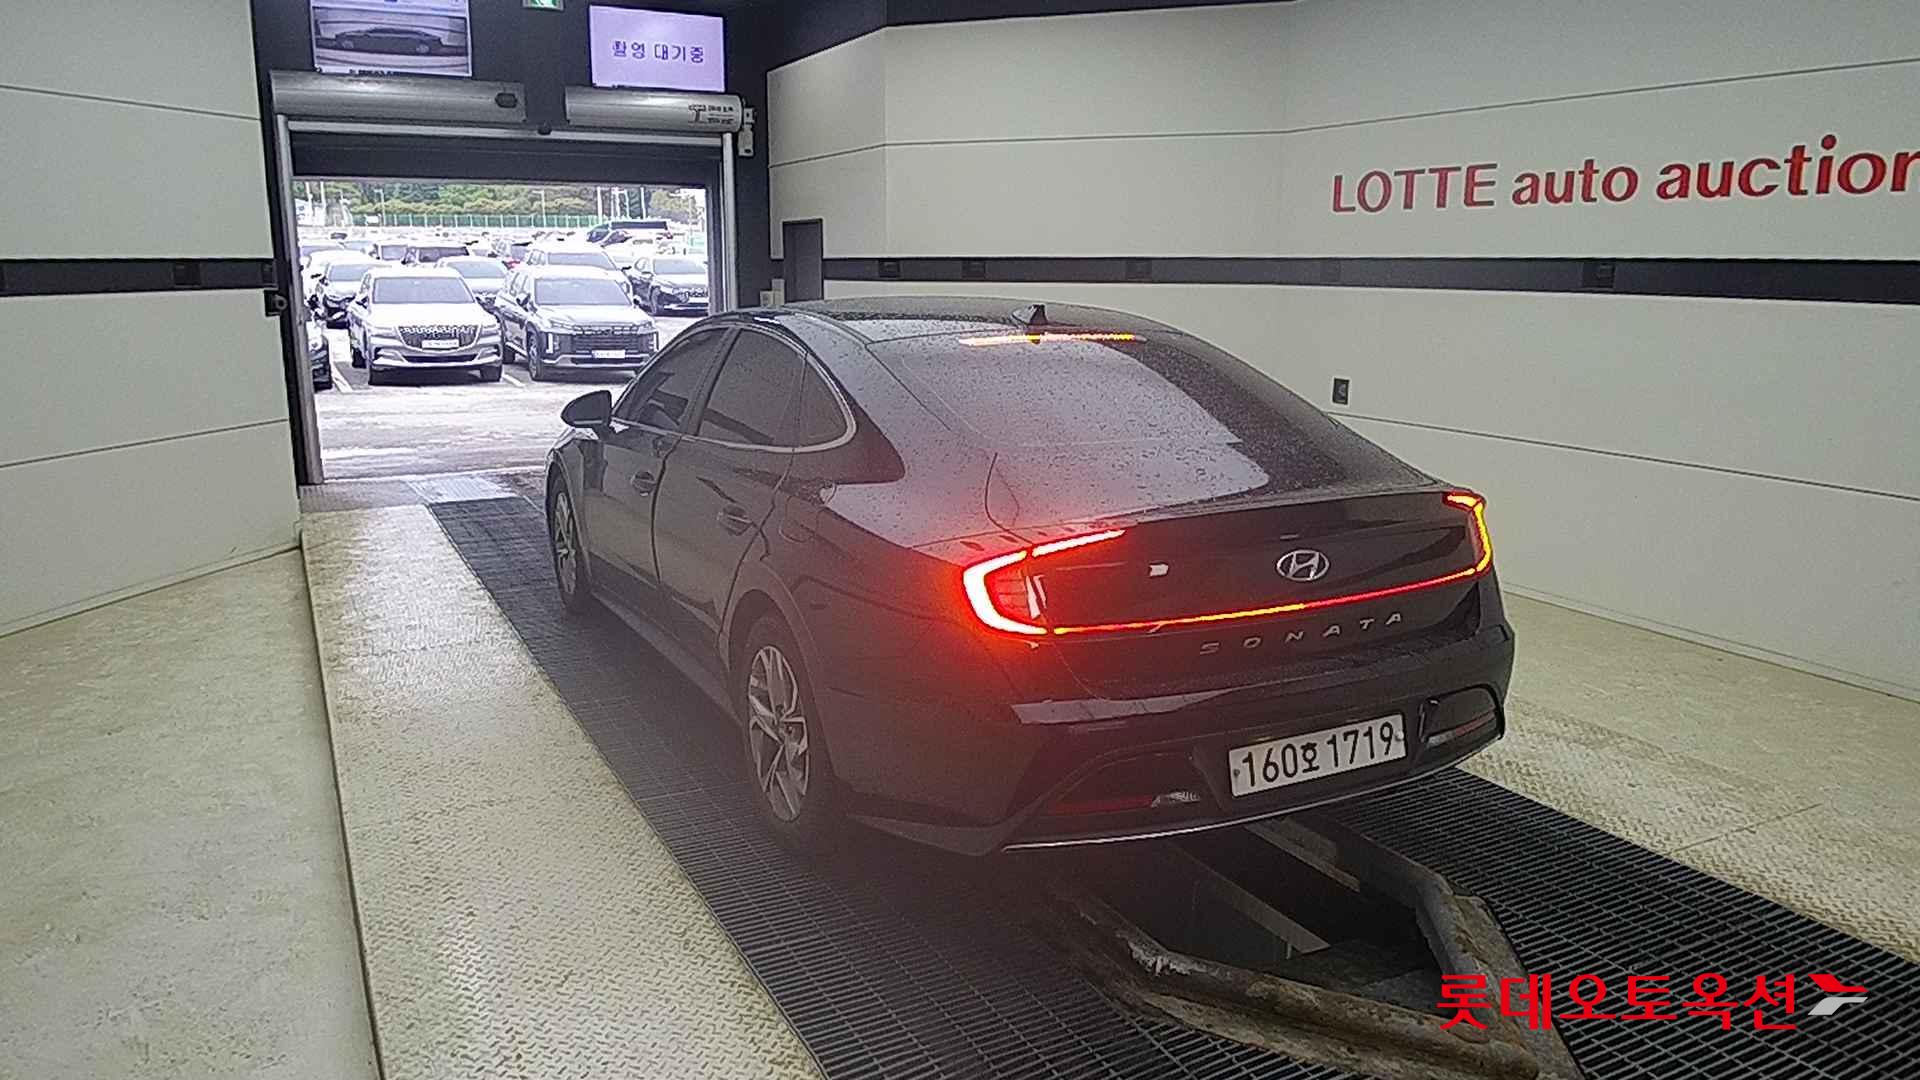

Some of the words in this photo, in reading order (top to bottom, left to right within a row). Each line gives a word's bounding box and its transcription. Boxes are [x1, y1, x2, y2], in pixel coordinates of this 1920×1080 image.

[654, 43, 704, 64] 대기중
[1332, 162, 1498, 213] LOTTE
[1512, 159, 1639, 205] auto
[1199, 613, 1402, 656] SONATA
